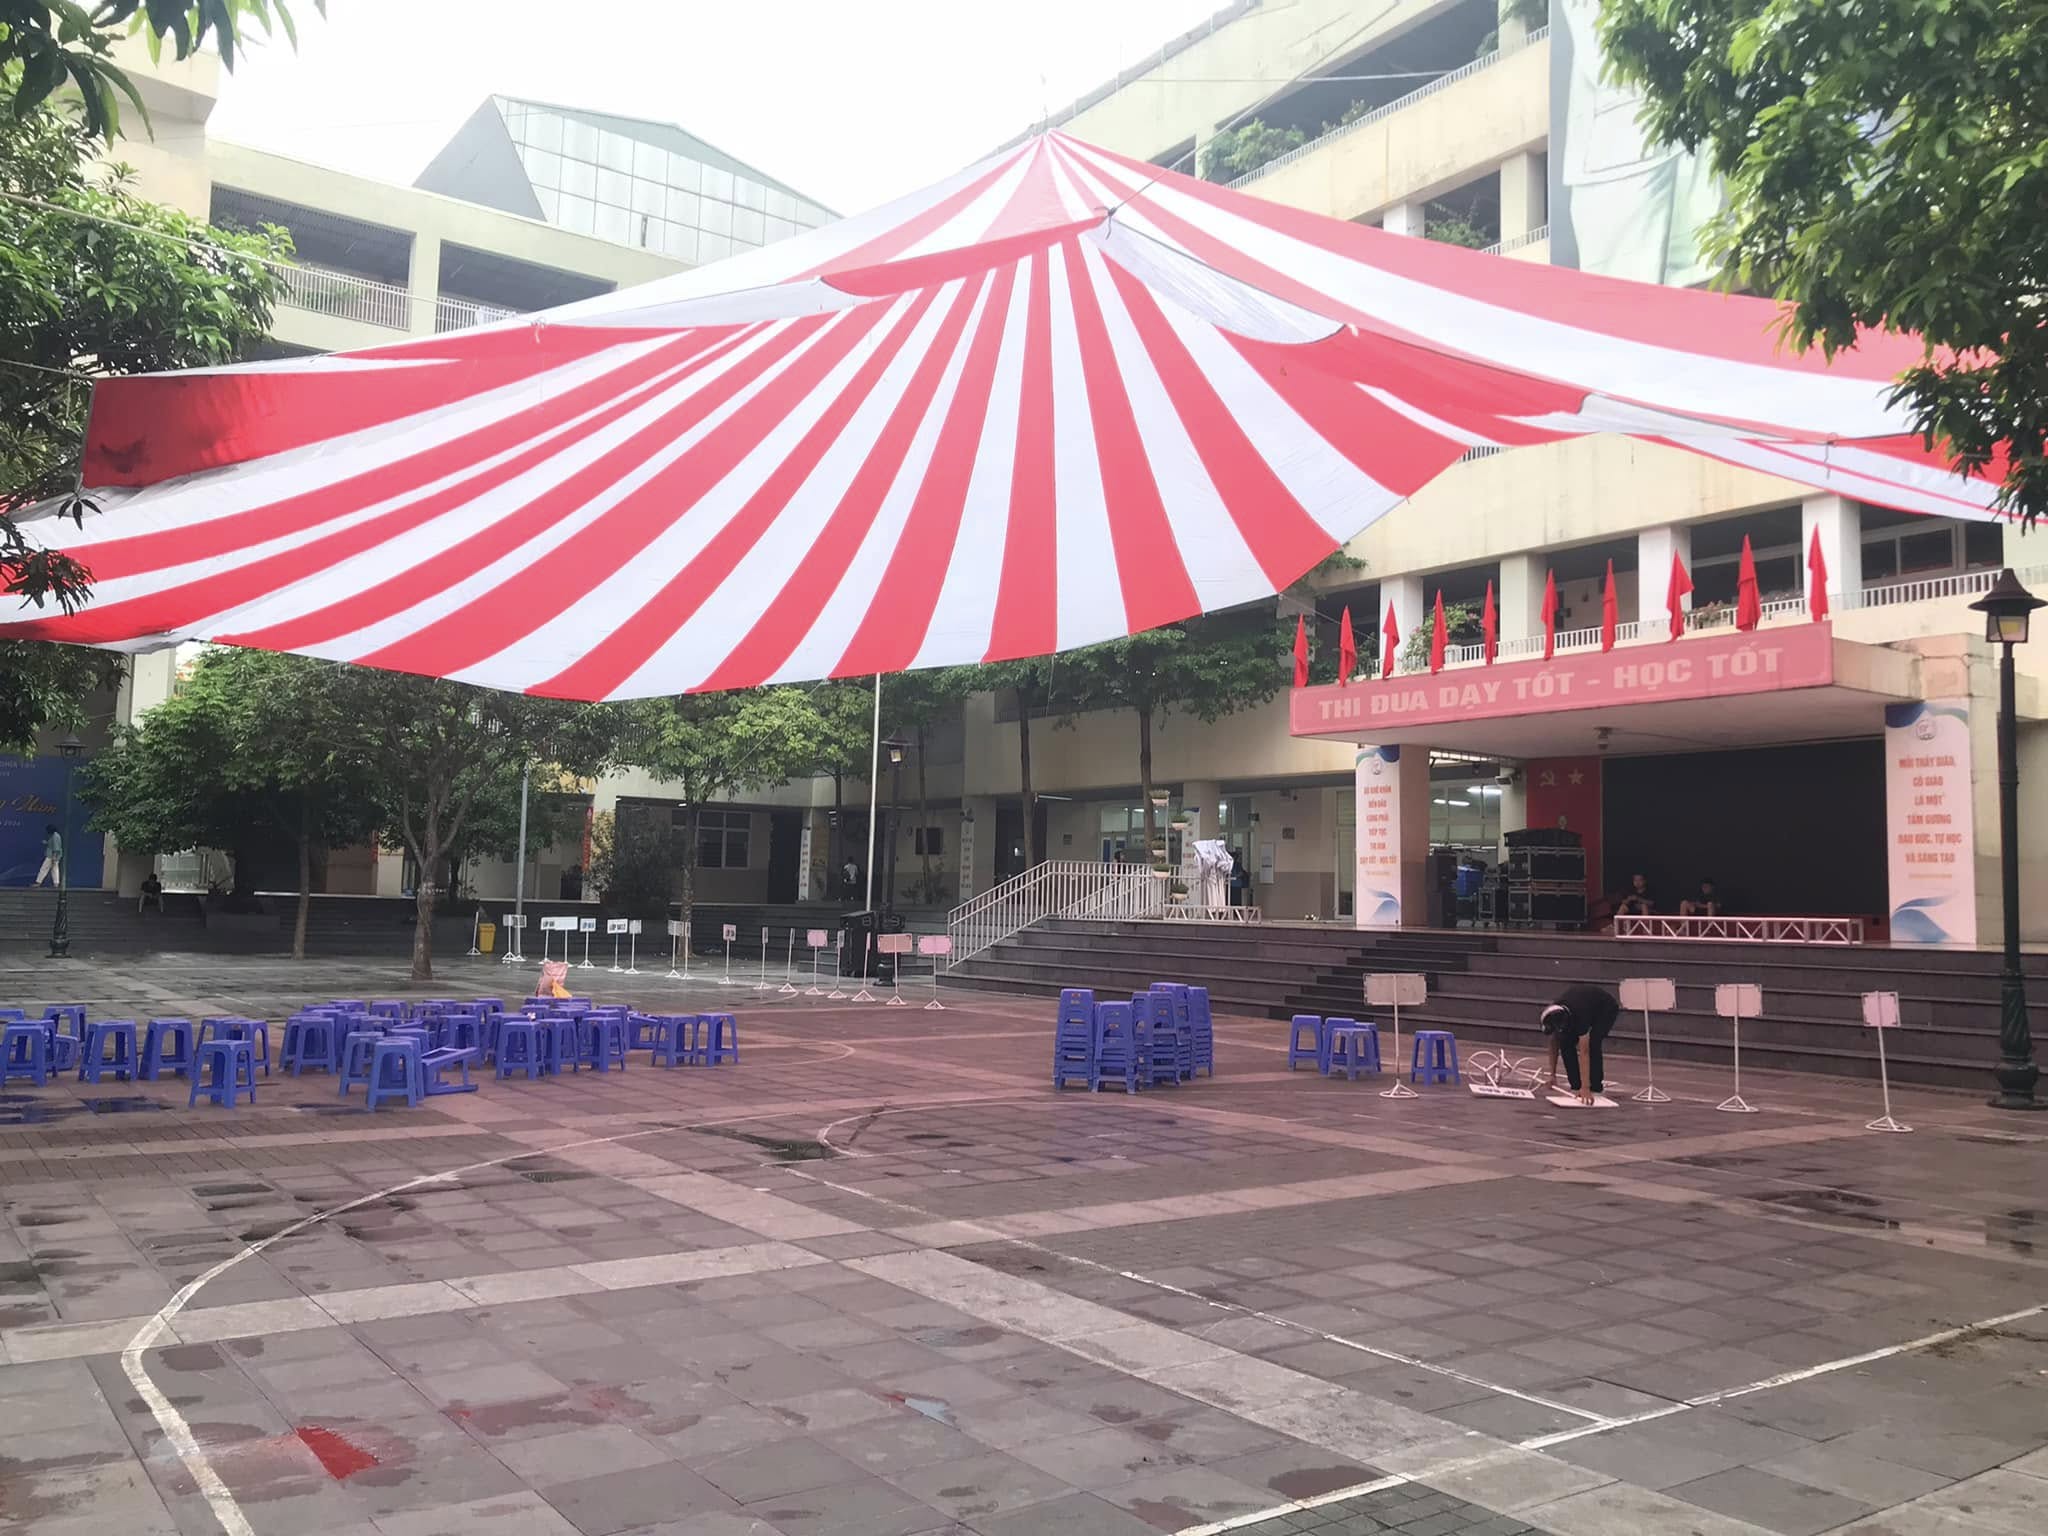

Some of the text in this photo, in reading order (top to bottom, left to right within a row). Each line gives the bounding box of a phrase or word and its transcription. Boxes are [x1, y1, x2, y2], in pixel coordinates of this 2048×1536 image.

[1319, 697, 1361, 721] THI
[1371, 689, 1429, 715] ĐUA
[1440, 684, 1501, 711] DẠY
[1513, 667, 1575, 700] TỐT
[1614, 658, 1693, 689] HỌC
[1707, 639, 1783, 678] TỐT
